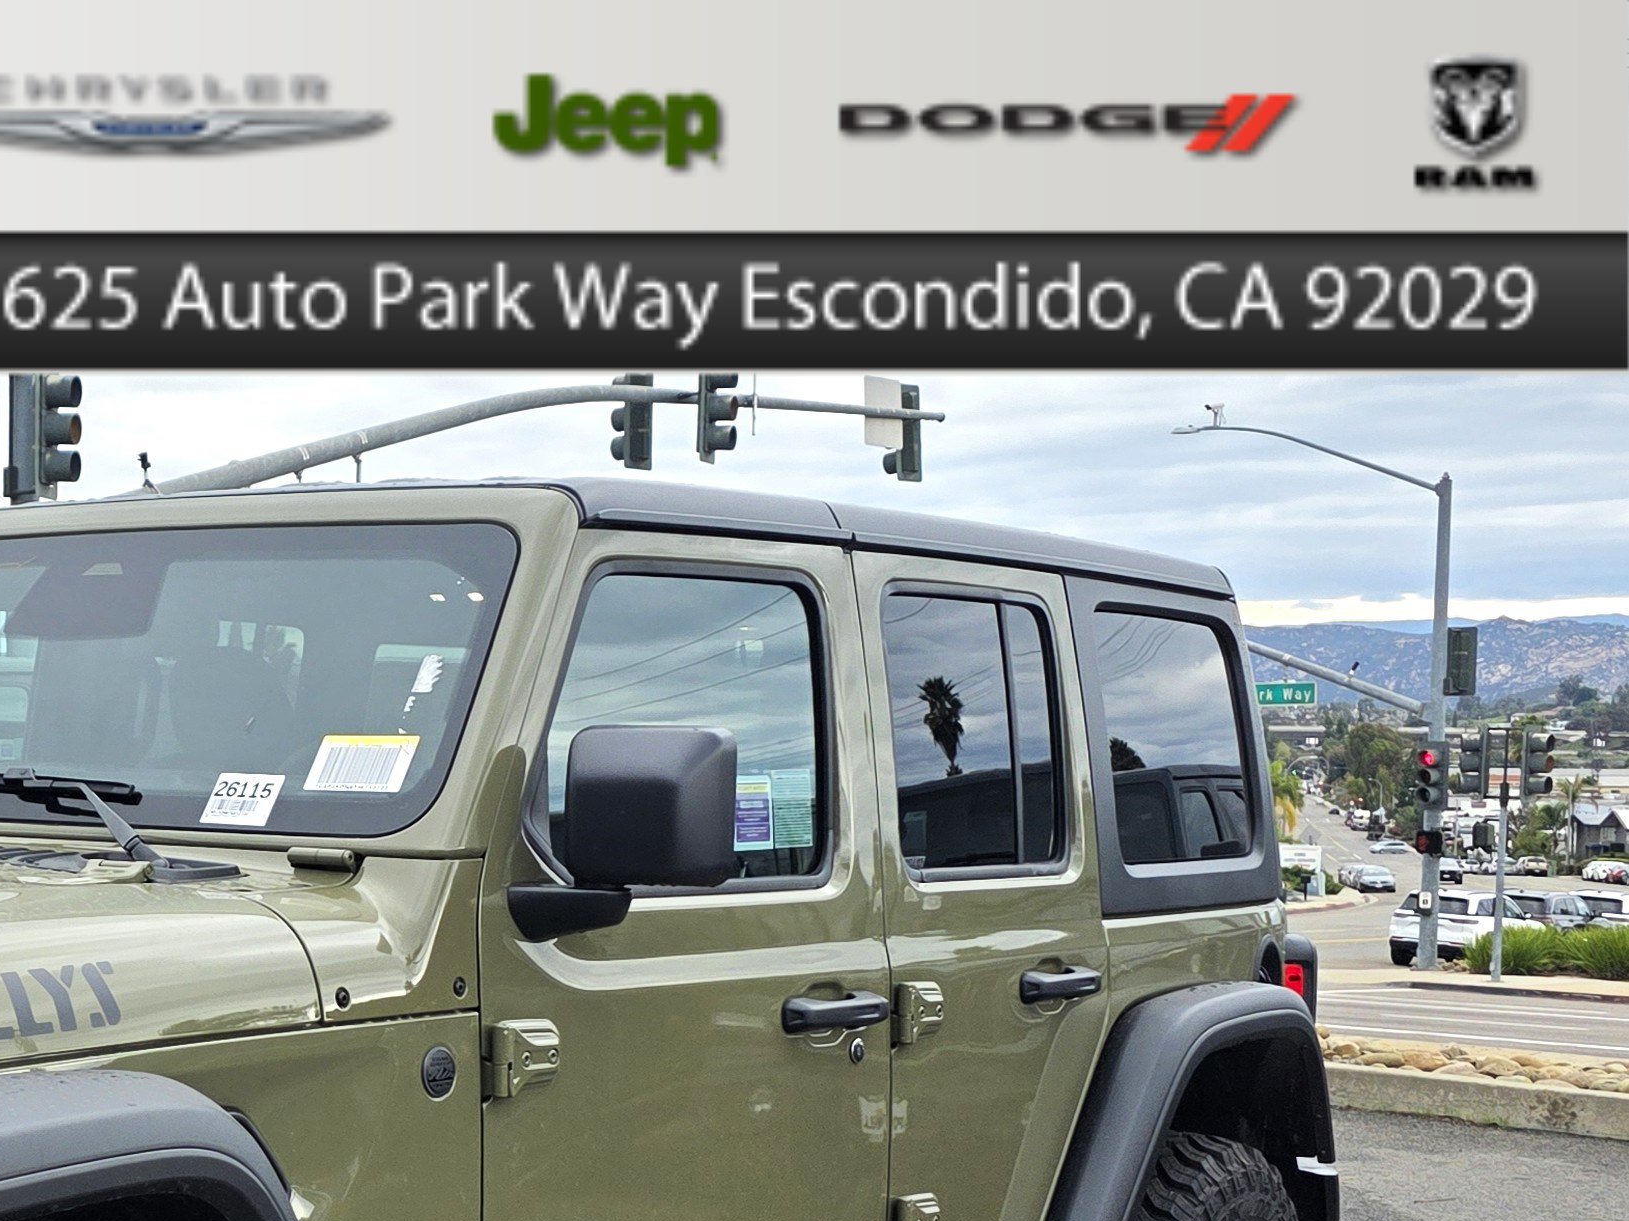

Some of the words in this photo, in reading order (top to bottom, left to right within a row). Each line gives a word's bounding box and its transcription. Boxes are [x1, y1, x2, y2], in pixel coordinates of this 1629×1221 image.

[1259, 688, 1273, 701] rk
[1283, 687, 1311, 703] Way
[214, 781, 274, 799] 26115
